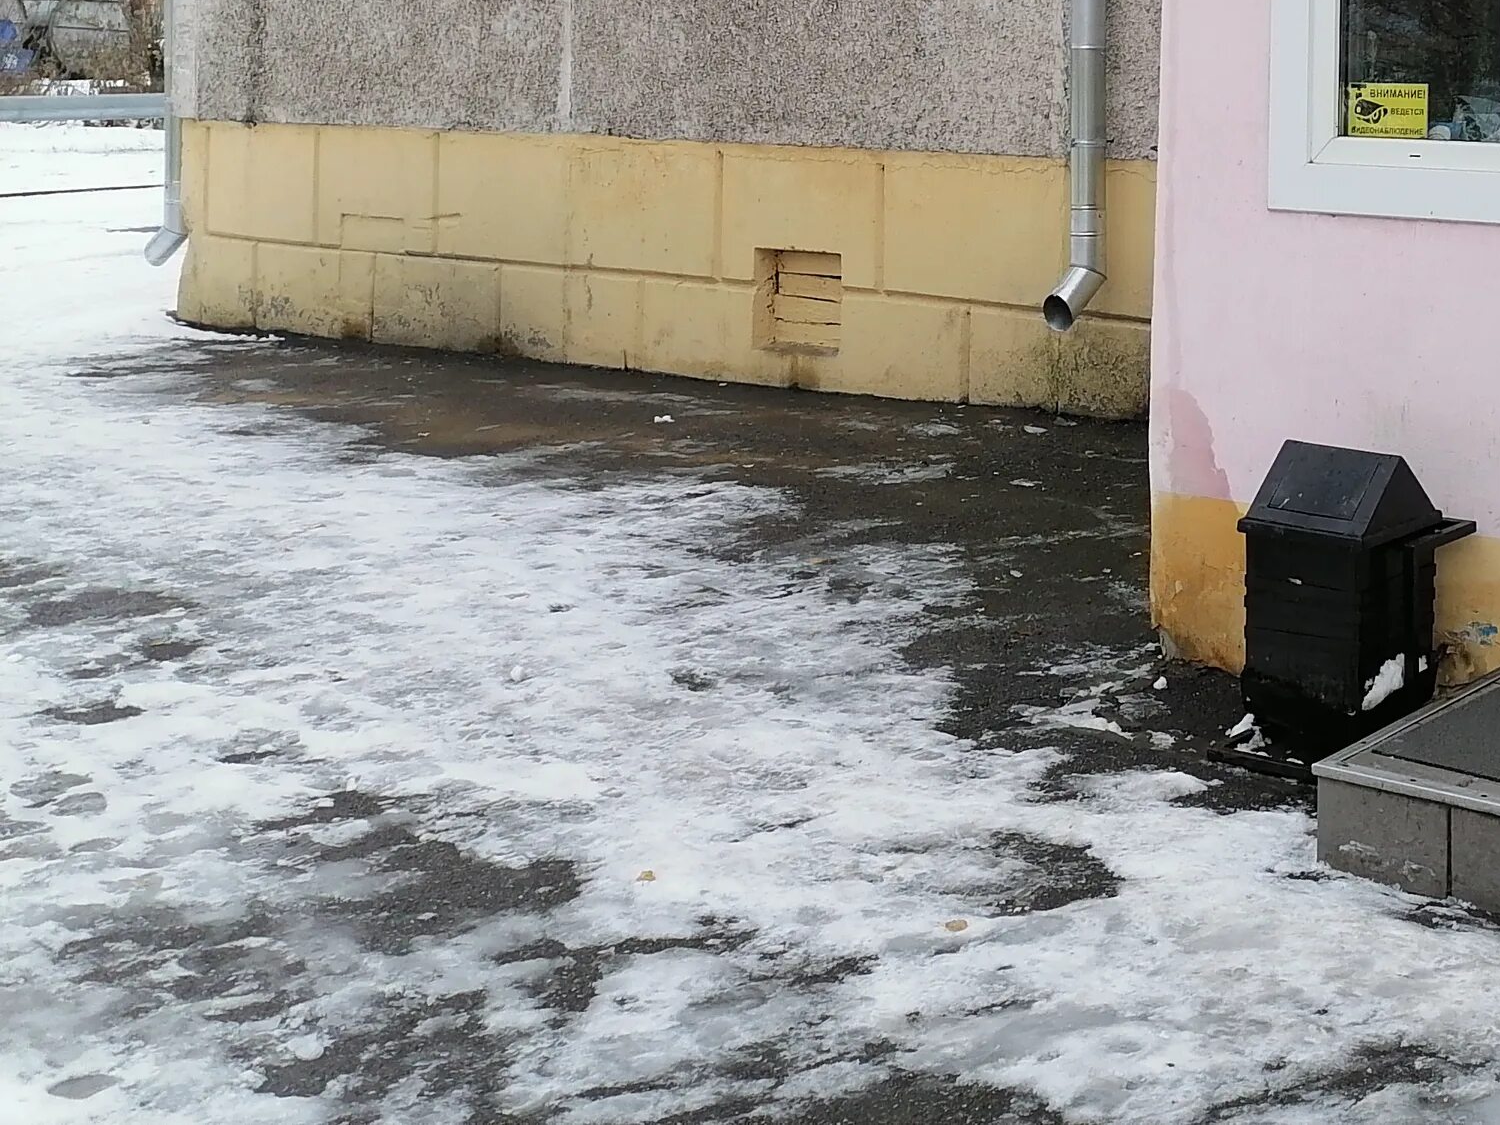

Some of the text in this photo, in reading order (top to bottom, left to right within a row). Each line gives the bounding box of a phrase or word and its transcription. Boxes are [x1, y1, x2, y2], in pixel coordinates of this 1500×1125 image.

[1369, 89, 1426, 99] ВНИМАНИЕ!
[1390, 107, 1424, 116] ВЕДЕТСЯ
[1351, 126, 1424, 135] ВИДЕОНАБЛЮДЕНИЕ
